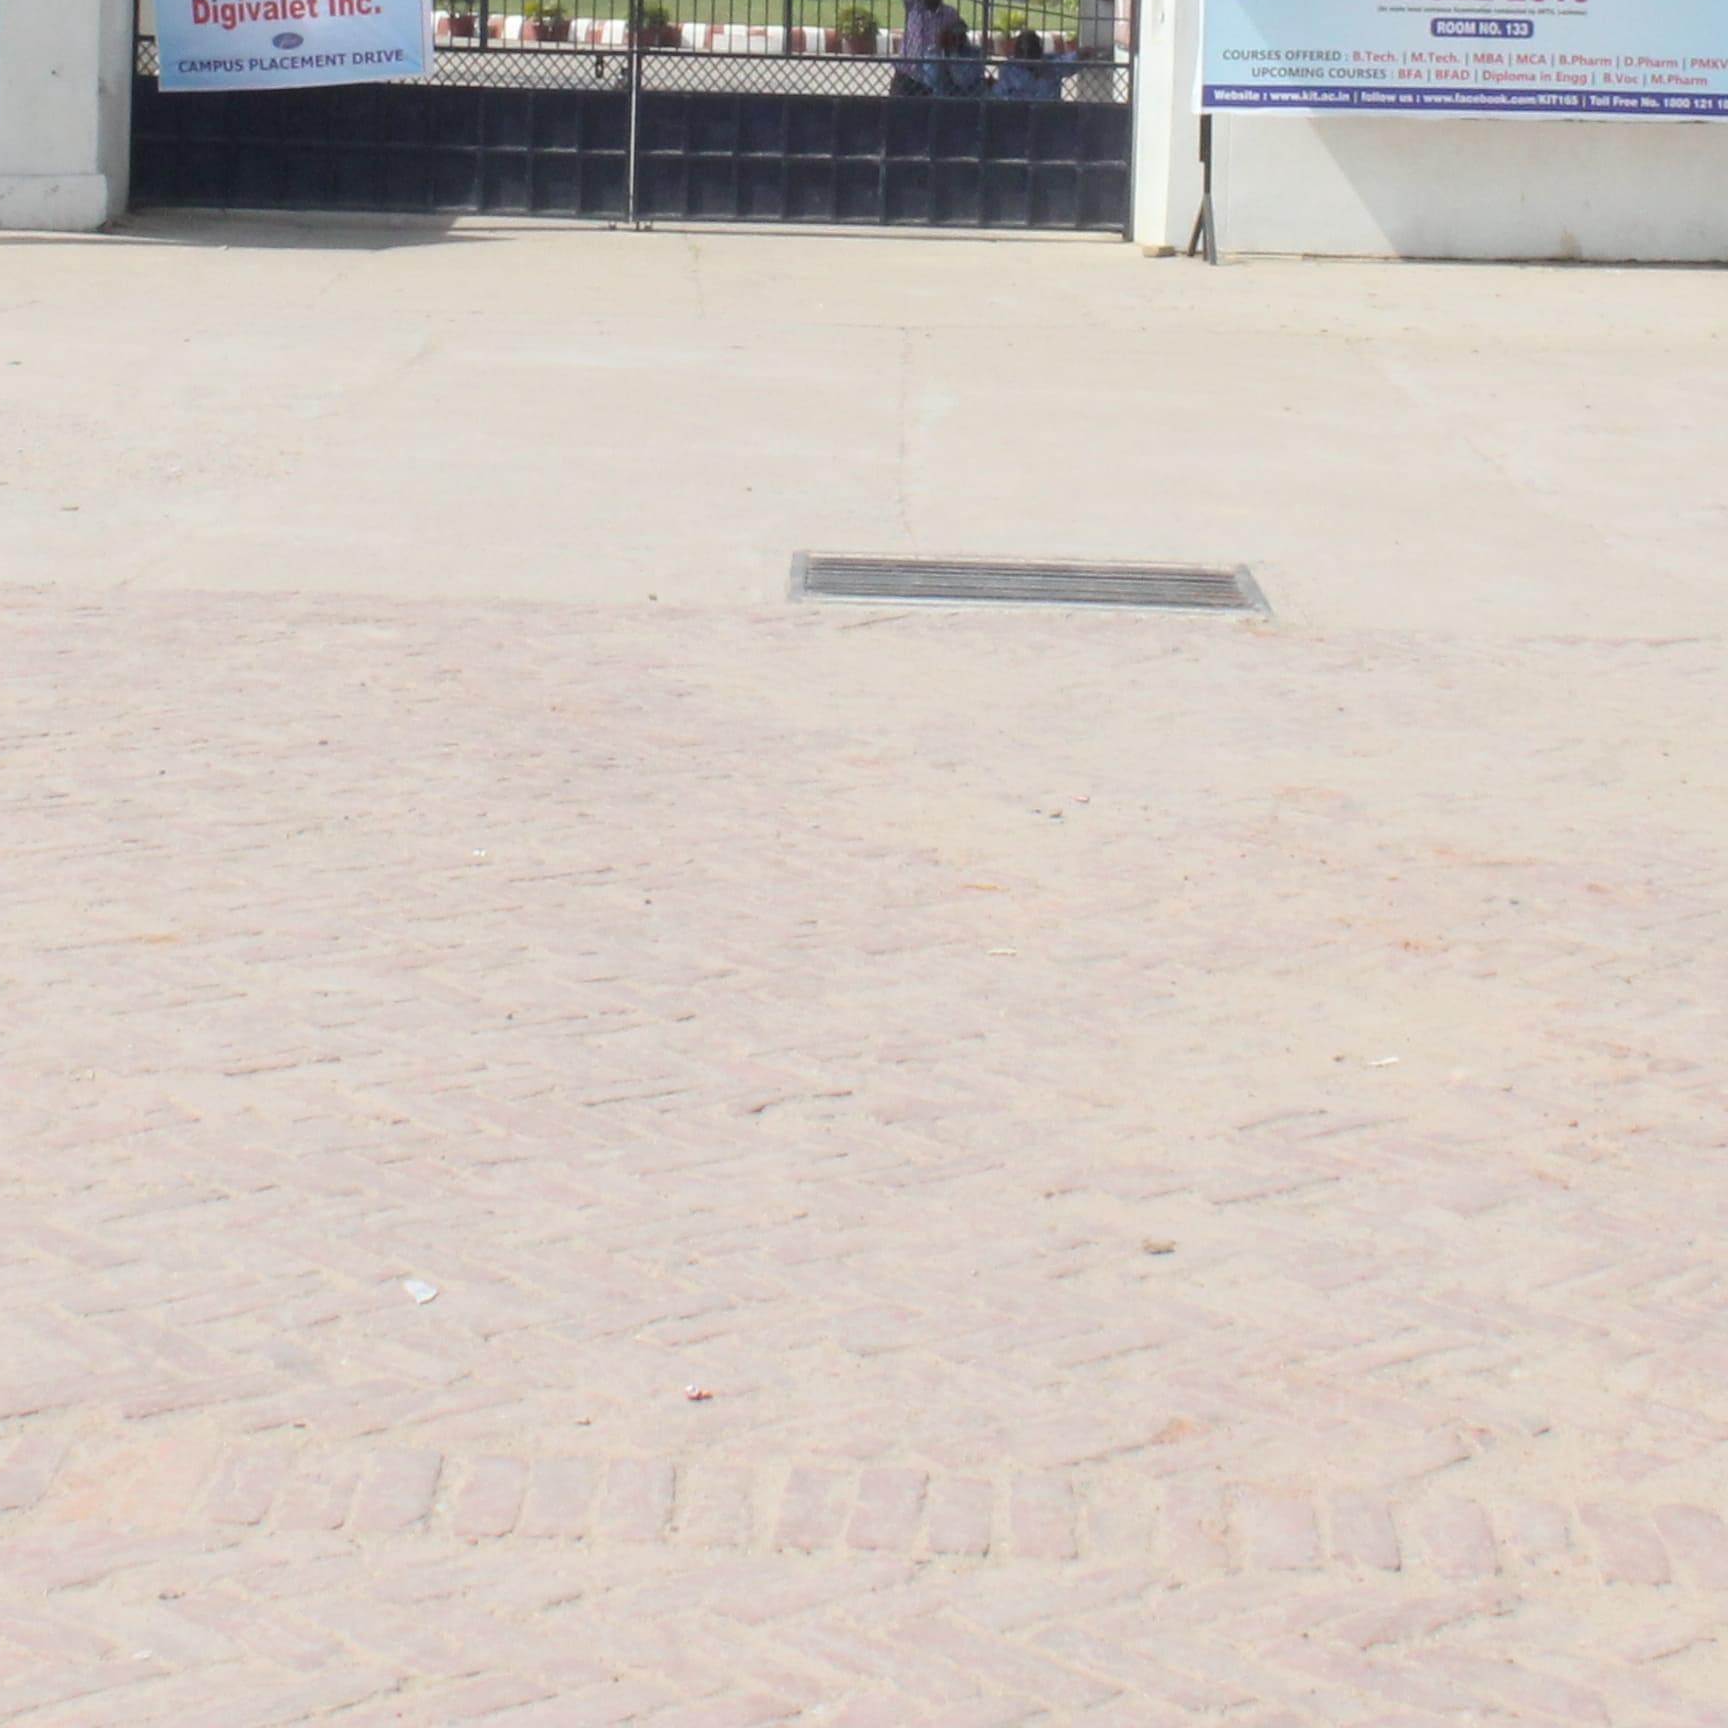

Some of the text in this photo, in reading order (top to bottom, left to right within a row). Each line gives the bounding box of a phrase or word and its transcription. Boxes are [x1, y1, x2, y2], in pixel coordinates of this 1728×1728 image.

[1437, 21, 1529, 36] ROOM NO. 133
[178, 49, 404, 73] CAMPUS PLACEMENT DRIVE
[1223, 50, 1281, 61] COURSES
[1285, 50, 1341, 62] OFFERED
[1353, 51, 1398, 63] B.Tech.
[1410, 52, 1461, 64] M.Tech.
[1473, 53, 1504, 65] MBA
[1516, 54, 1546, 65] MCA
[1559, 55, 1612, 67] B.Pharm
[1624, 57, 1678, 68] D.Pharm
[1251, 68, 1707, 86] UPCOMING COURSES BFA BFAD Diploma in Engg B.Voc M.Pharm
[1214, 89, 1260, 101] Website
[1270, 90, 1350, 102] www.kit.ac.in
[1362, 91, 1396, 103] follow
[1399, 94, 1413, 103] us
[1590, 96, 1609, 106] Toll
[1613, 96, 1638, 107] Free
[1640, 97, 1659, 108] No.
[1694, 98, 1713, 109] 121
